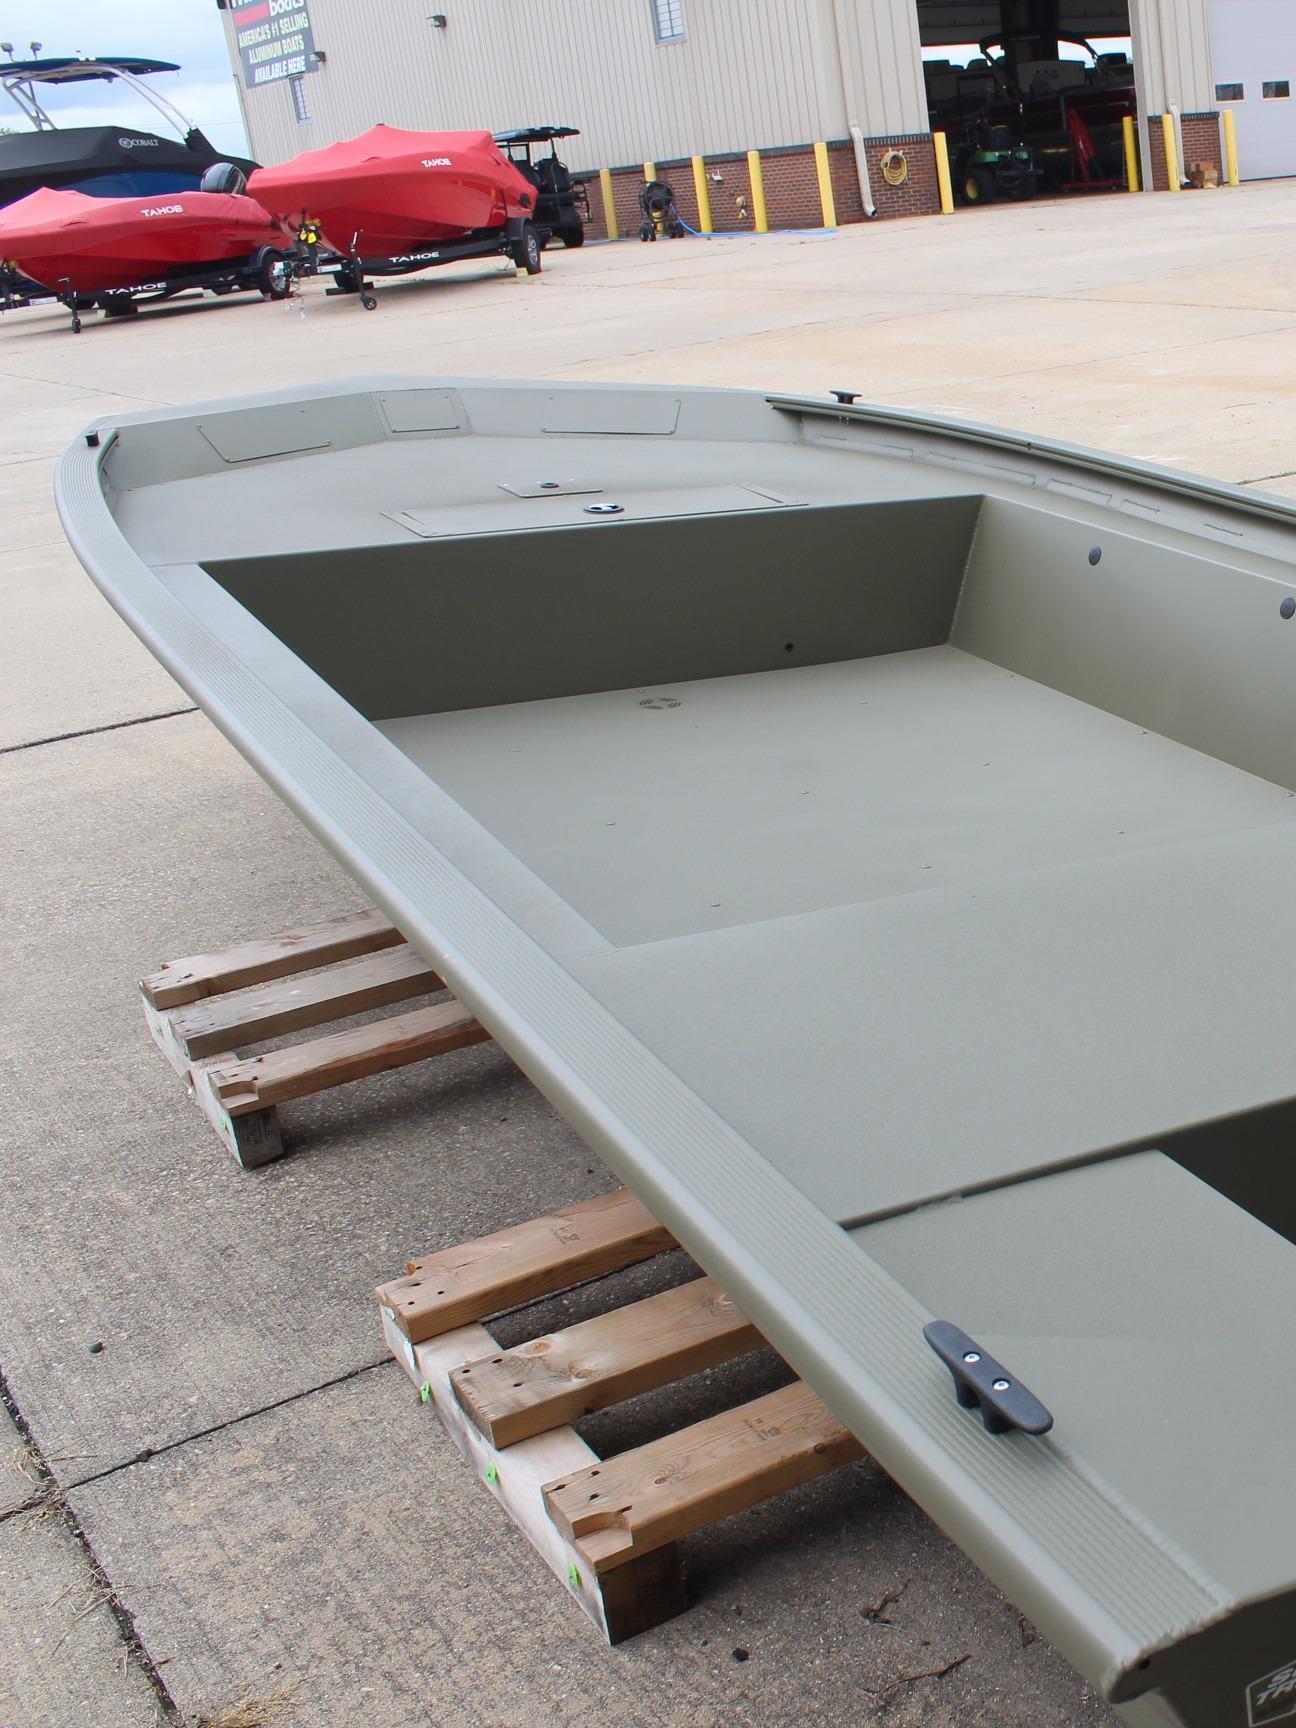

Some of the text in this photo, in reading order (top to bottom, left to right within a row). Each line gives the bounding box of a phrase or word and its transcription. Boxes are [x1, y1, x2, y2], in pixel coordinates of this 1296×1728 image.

[280, 12, 309, 34] SELLING
[249, 34, 305, 64] ALUMINUM BOATS
[255, 56, 306, 84] AVAILABLE HERE
[421, 158, 452, 168] TAHOE
[141, 204, 184, 217] TAHOE
[388, 251, 440, 263] TAHOE
[104, 281, 167, 295] TAHOE
